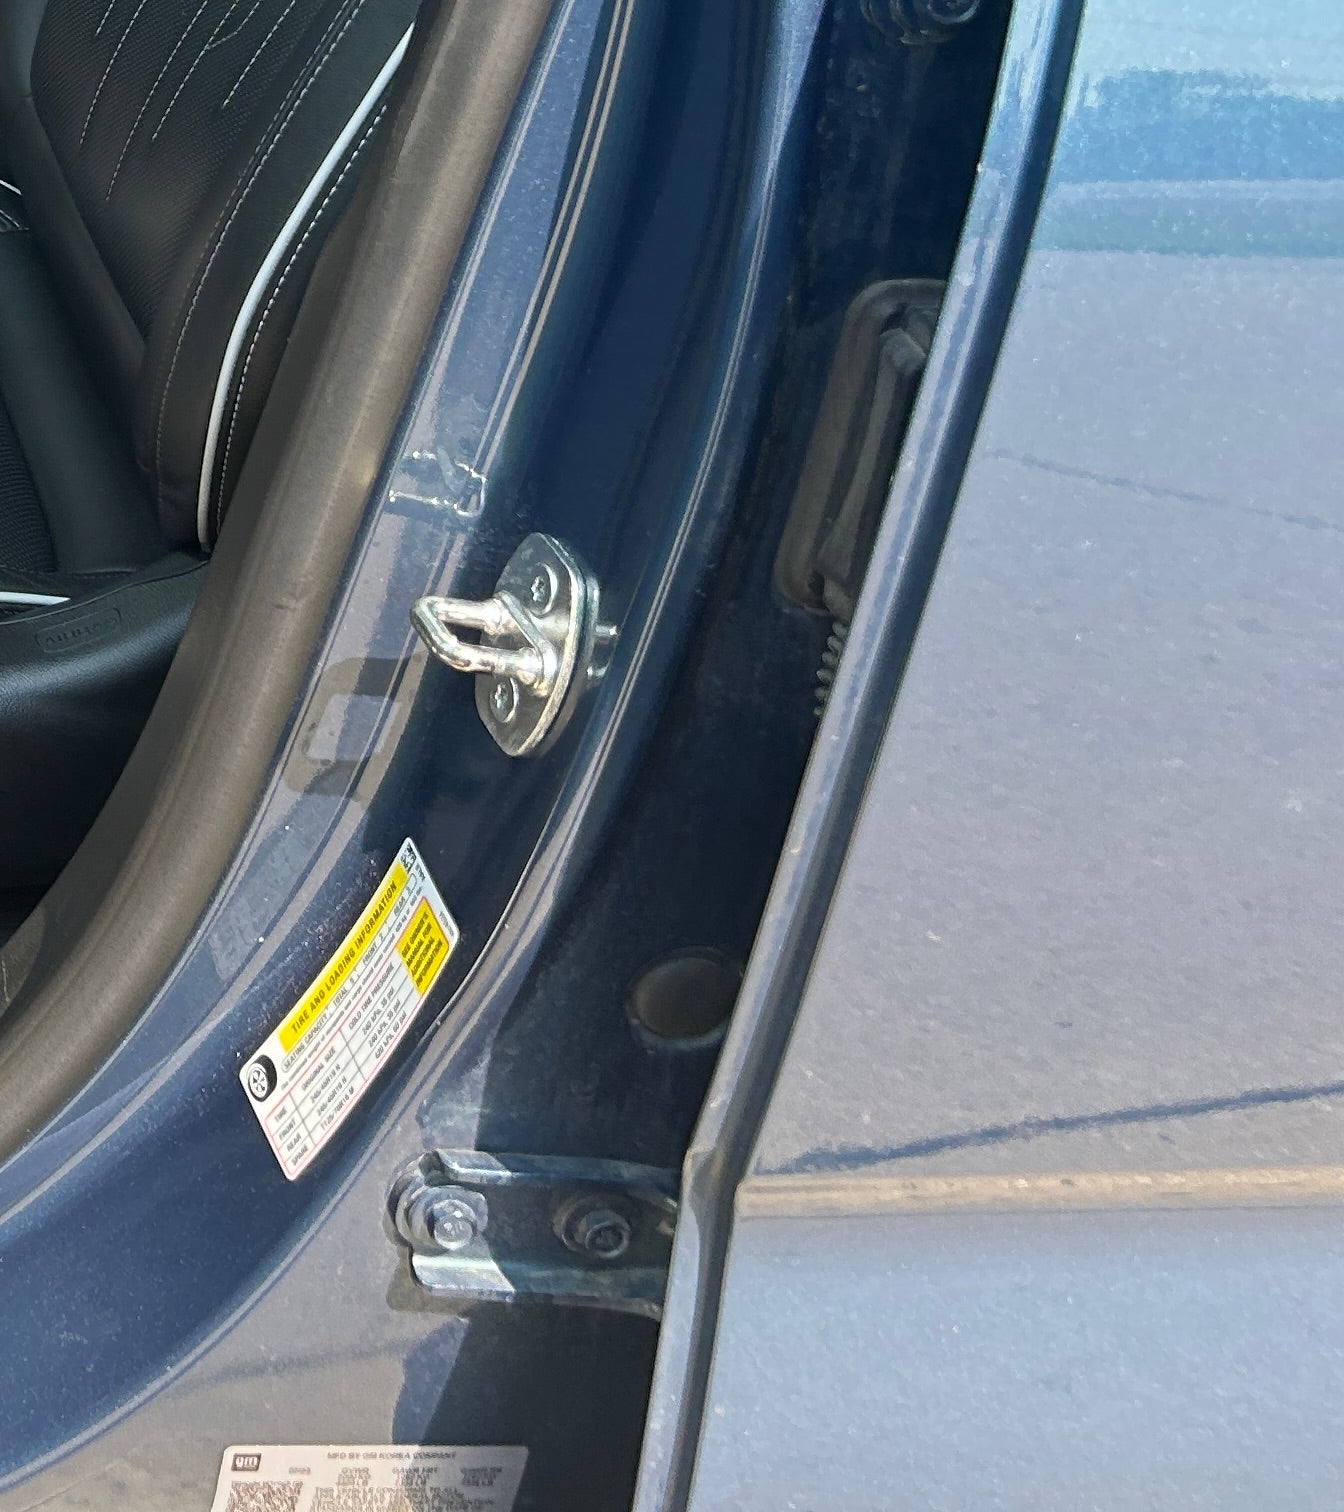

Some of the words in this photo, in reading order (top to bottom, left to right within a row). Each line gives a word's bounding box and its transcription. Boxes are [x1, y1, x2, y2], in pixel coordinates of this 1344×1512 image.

[291, 1008, 310, 1034] TIRE
[308, 987, 326, 1013] AND
[324, 945, 355, 991] LOADING
[354, 880, 397, 950] INFORMATION
